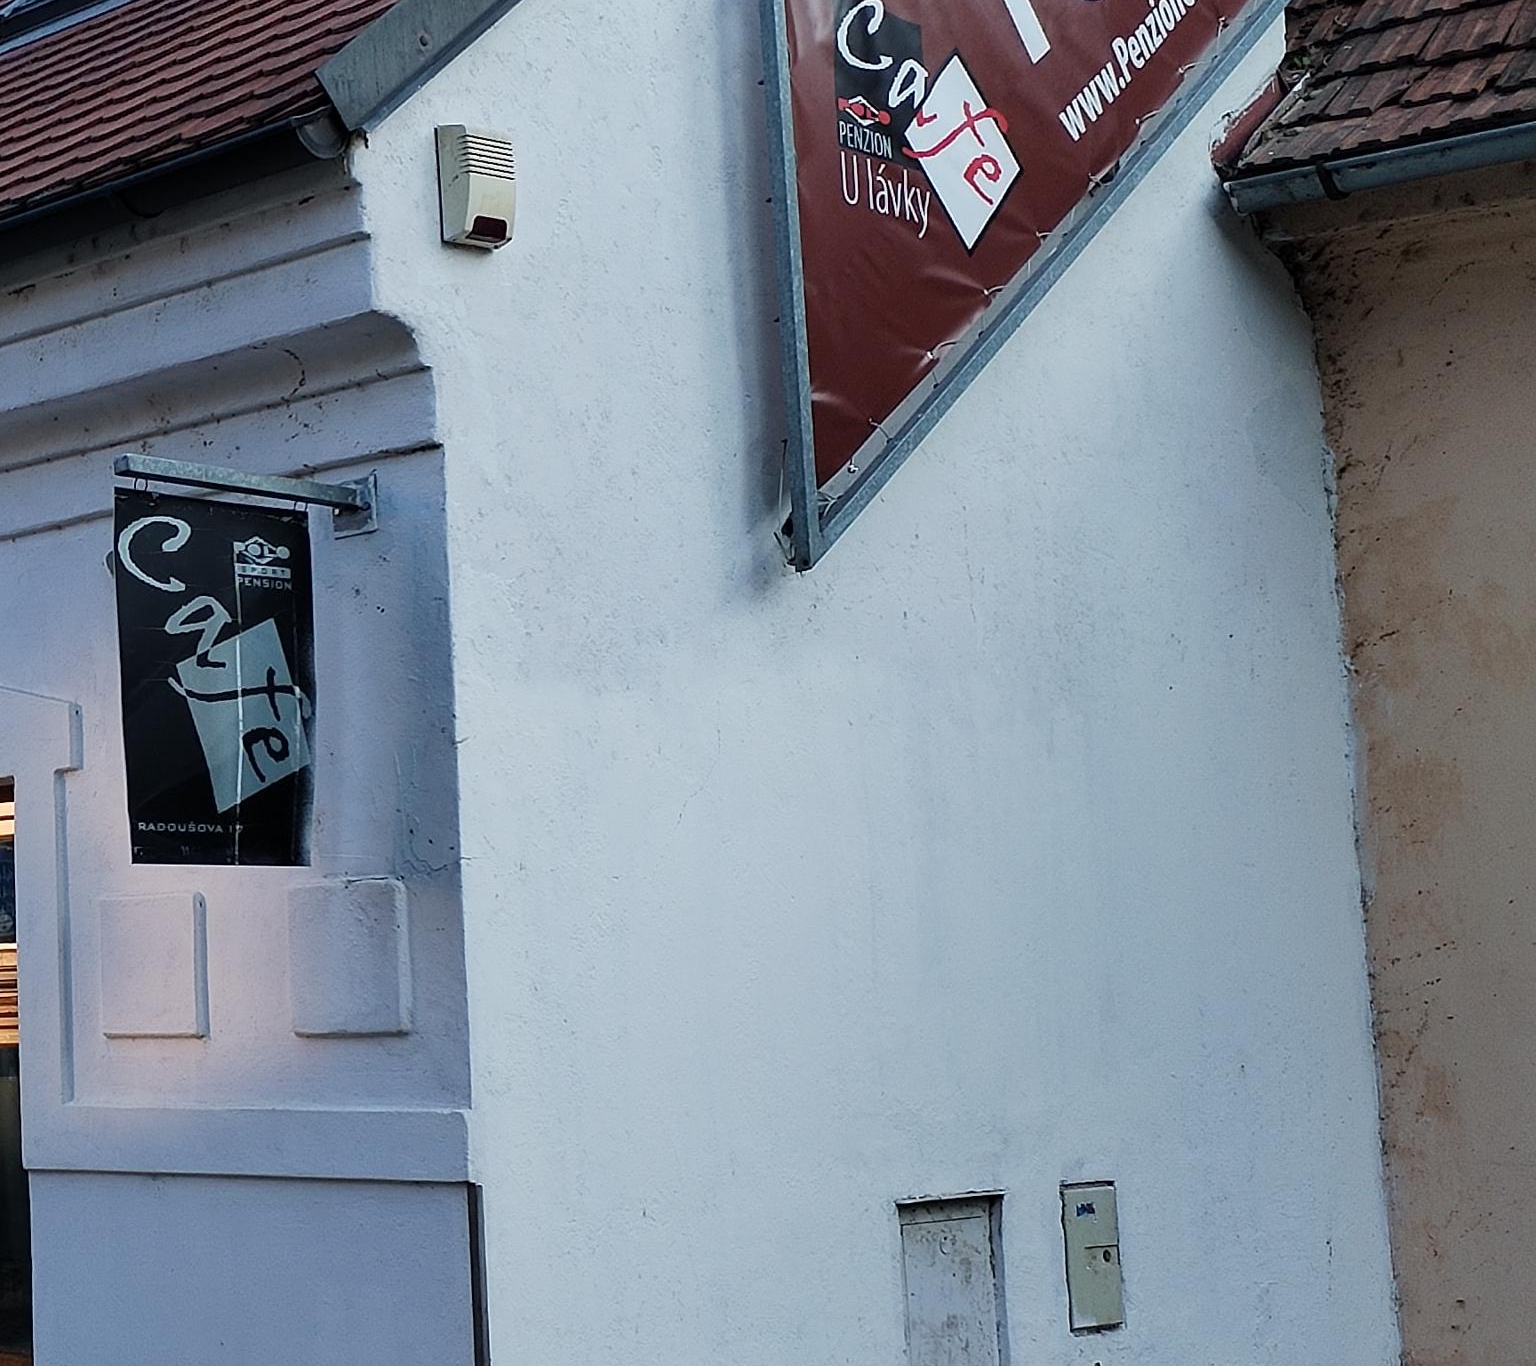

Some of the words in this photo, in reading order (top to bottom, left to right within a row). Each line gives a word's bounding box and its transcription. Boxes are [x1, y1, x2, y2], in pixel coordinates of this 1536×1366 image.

[839, 120, 893, 160] PENZION
[841, 151, 860, 205] U
[866, 158, 931, 239] lávky
[235, 576, 293, 590] PENSION
[138, 821, 224, 833] RADOUŠOVA
